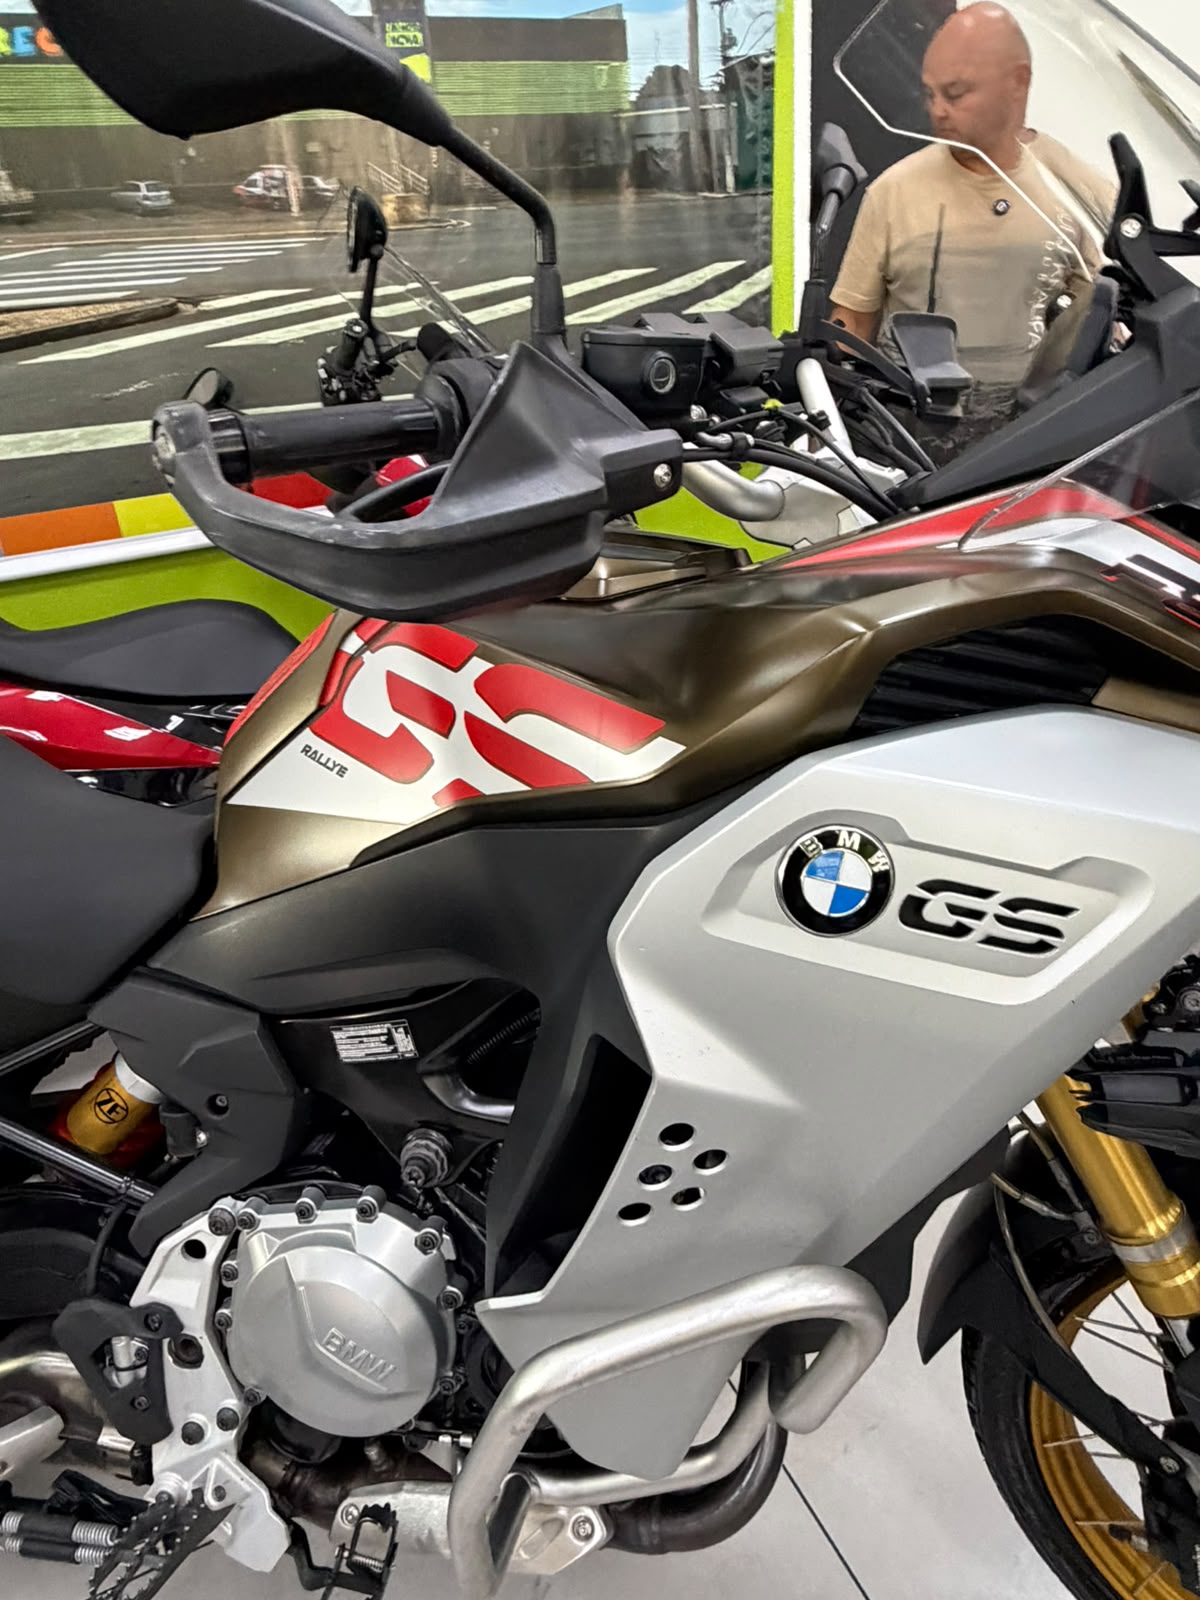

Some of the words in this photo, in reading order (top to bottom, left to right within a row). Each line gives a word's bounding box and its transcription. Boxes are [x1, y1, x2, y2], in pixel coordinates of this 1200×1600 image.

[300, 744, 349, 778] RALLYE
[799, 829, 891, 874] BMW
[898, 878, 1081, 956] GS
[95, 1088, 129, 1124] ZF
[322, 1327, 398, 1382] BMW
